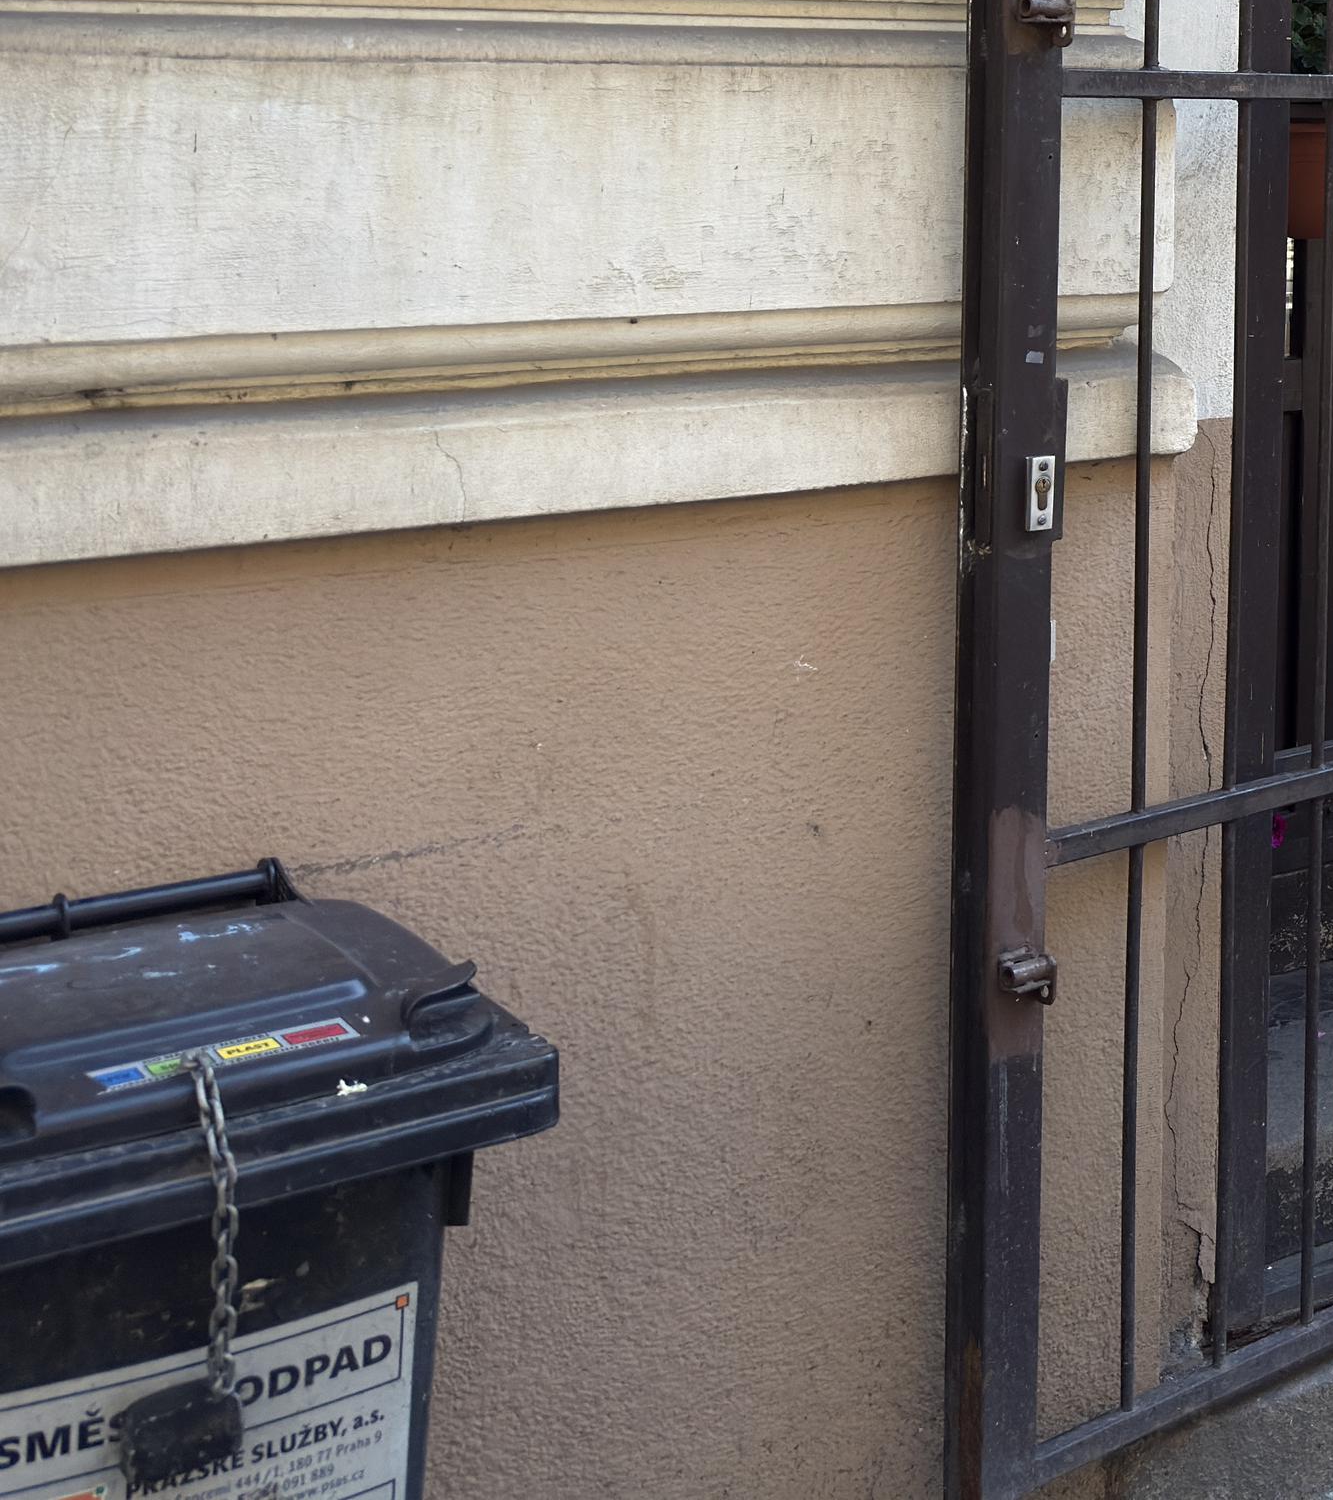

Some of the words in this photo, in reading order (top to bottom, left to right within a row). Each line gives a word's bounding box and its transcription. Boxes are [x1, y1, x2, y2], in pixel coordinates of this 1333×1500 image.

[235, 1334, 392, 1407] ODPAD
[251, 1416, 347, 1464] SLUŽBY,
[353, 1409, 385, 1431] a.s.
[335, 1437, 371, 1458] Praha
[374, 1430, 382, 1443] 9
